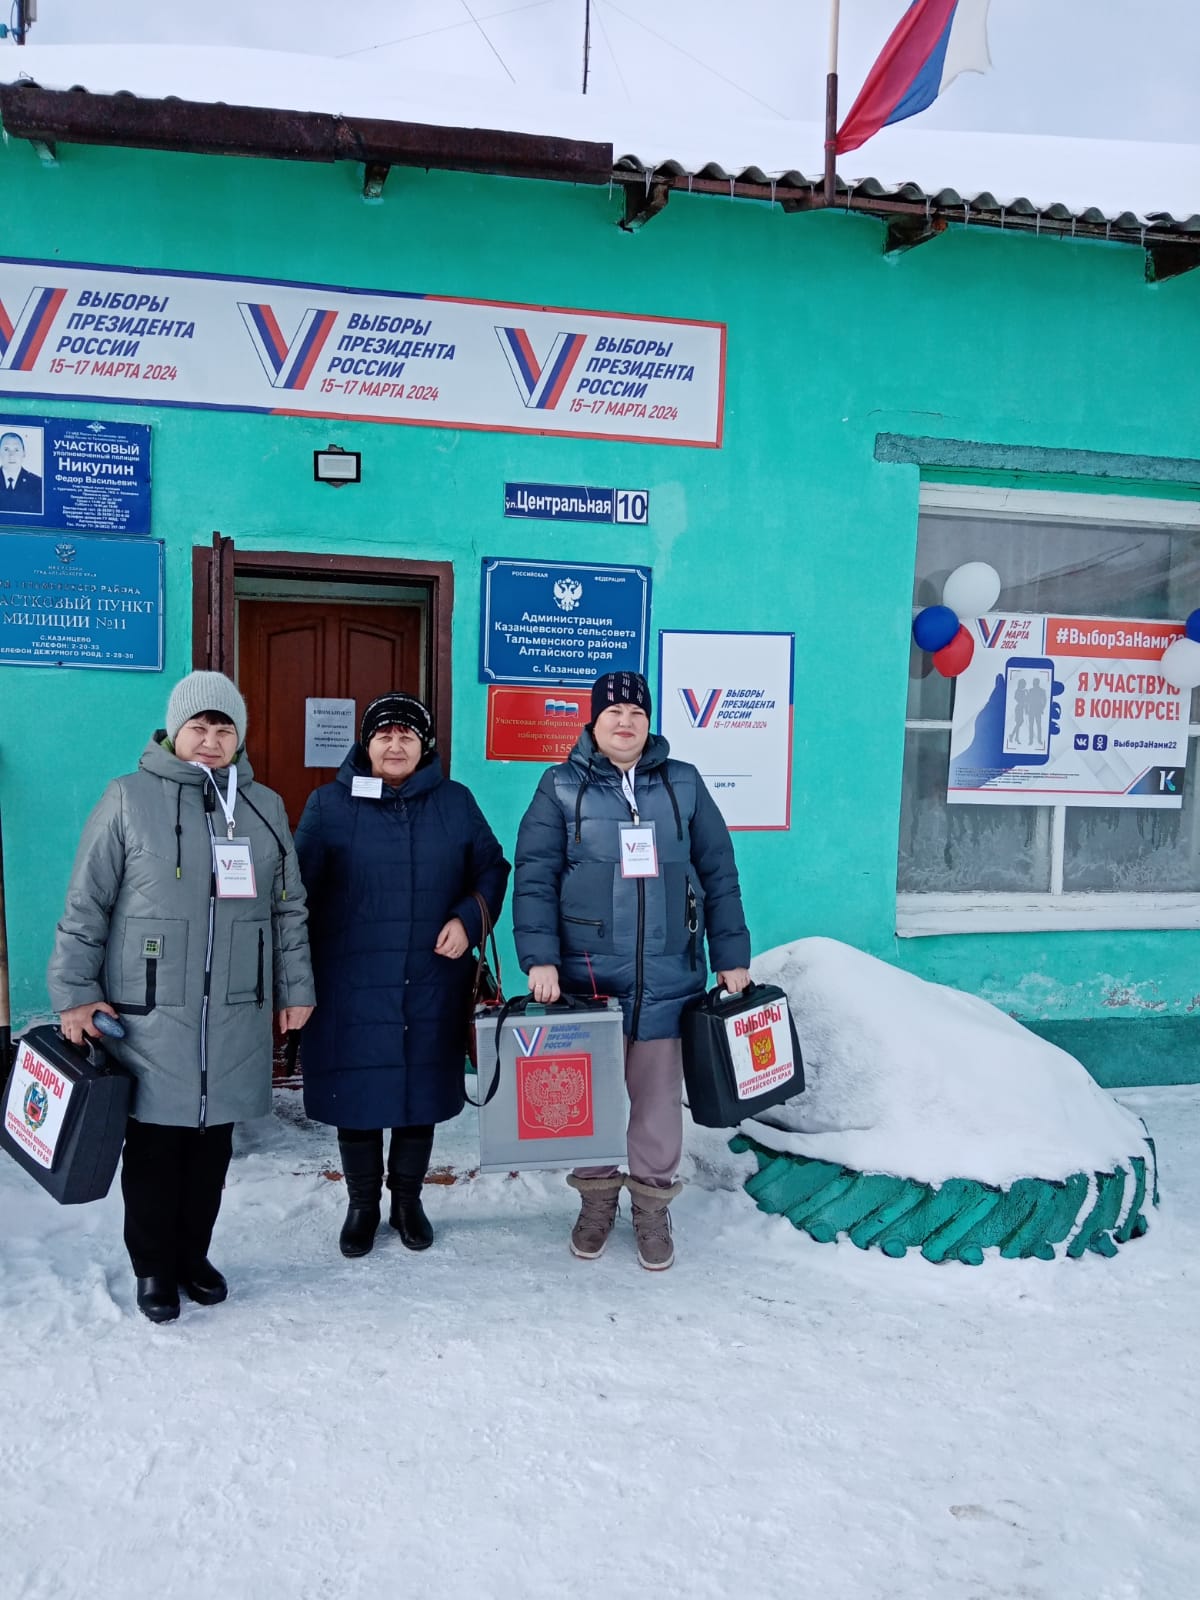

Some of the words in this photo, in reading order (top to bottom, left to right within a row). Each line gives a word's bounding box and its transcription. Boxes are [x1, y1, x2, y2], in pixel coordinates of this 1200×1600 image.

[77, 290, 169, 313] ВЫБОРЫ
[66, 313, 196, 339] ПРЕЗИДЕНТА
[347, 313, 432, 336] ВЫБОРЫ
[56, 336, 140, 357] РОССИИ
[337, 335, 456, 360] ПРЕЗИДЕНТА
[595, 336, 673, 357] ВЫБОРЫ
[91, 361, 140, 379] МАРТА
[143, 364, 177, 380] 2024
[327, 357, 405, 378] РОССИИ
[585, 357, 695, 381] ПРЕЗИДЕНТА
[360, 381, 404, 398] МАРТА
[406, 385, 439, 401] 2024
[576, 378, 648, 398] РОССИИ
[605, 401, 646, 418] МАРТА
[648, 405, 678, 420] 2024
[53, 440, 140, 455] УЧАСТКОВЫЙ
[53, 451, 110, 460] уполномоченный
[58, 457, 134, 476] Никулин
[55, 474, 84, 484] Федор
[85, 476, 137, 487] Васильевич
[618, 494, 645, 520] 10
[511, 570, 549, 578] РОССИЙСКАЯ
[101, 584, 141, 595] РАЙОНА
[97, 598, 154, 613] ПУНКТ
[2, 611, 90, 629] МИЛИЦИИ
[521, 612, 613, 626] Администрация
[495, 621, 575, 635] Казанцевского
[577, 627, 636, 638] сельсовета
[1004, 630, 1030, 640] МАРТА
[32, 641, 70, 649] ТЕЛЕФОН:
[504, 633, 585, 648] Тальменского
[587, 638, 628, 653] района
[1000, 641, 1018, 650] 2024
[33, 649, 79, 657] ДЕЖУРНОГО
[519, 646, 585, 659] Алтайского
[587, 650, 613, 661] края
[544, 664, 597, 675] Казанцево
[1077, 672, 1089, 692] Я
[726, 689, 765, 698] ВЫБОРЫ
[721, 700, 776, 710] ПРЕЗИДЕНТА
[1074, 698, 1086, 718] В
[1090, 698, 1180, 722] КОНКУРСЕ!
[495, 717, 537, 726] Участковая
[716, 710, 752, 719] РОССИИ
[731, 721, 752, 729] МАРТА
[752, 721, 768, 729] 2024
[1113, 740, 1177, 749] ВыборЗаНами22
[733, 1005, 782, 1038] ВЫБОРЫ
[22, 1050, 65, 1100] ВЫБОРЫ
[741, 1076, 777, 1097] АЛТАЙСКОГО
[777, 1070, 792, 1081] КРАЯ
